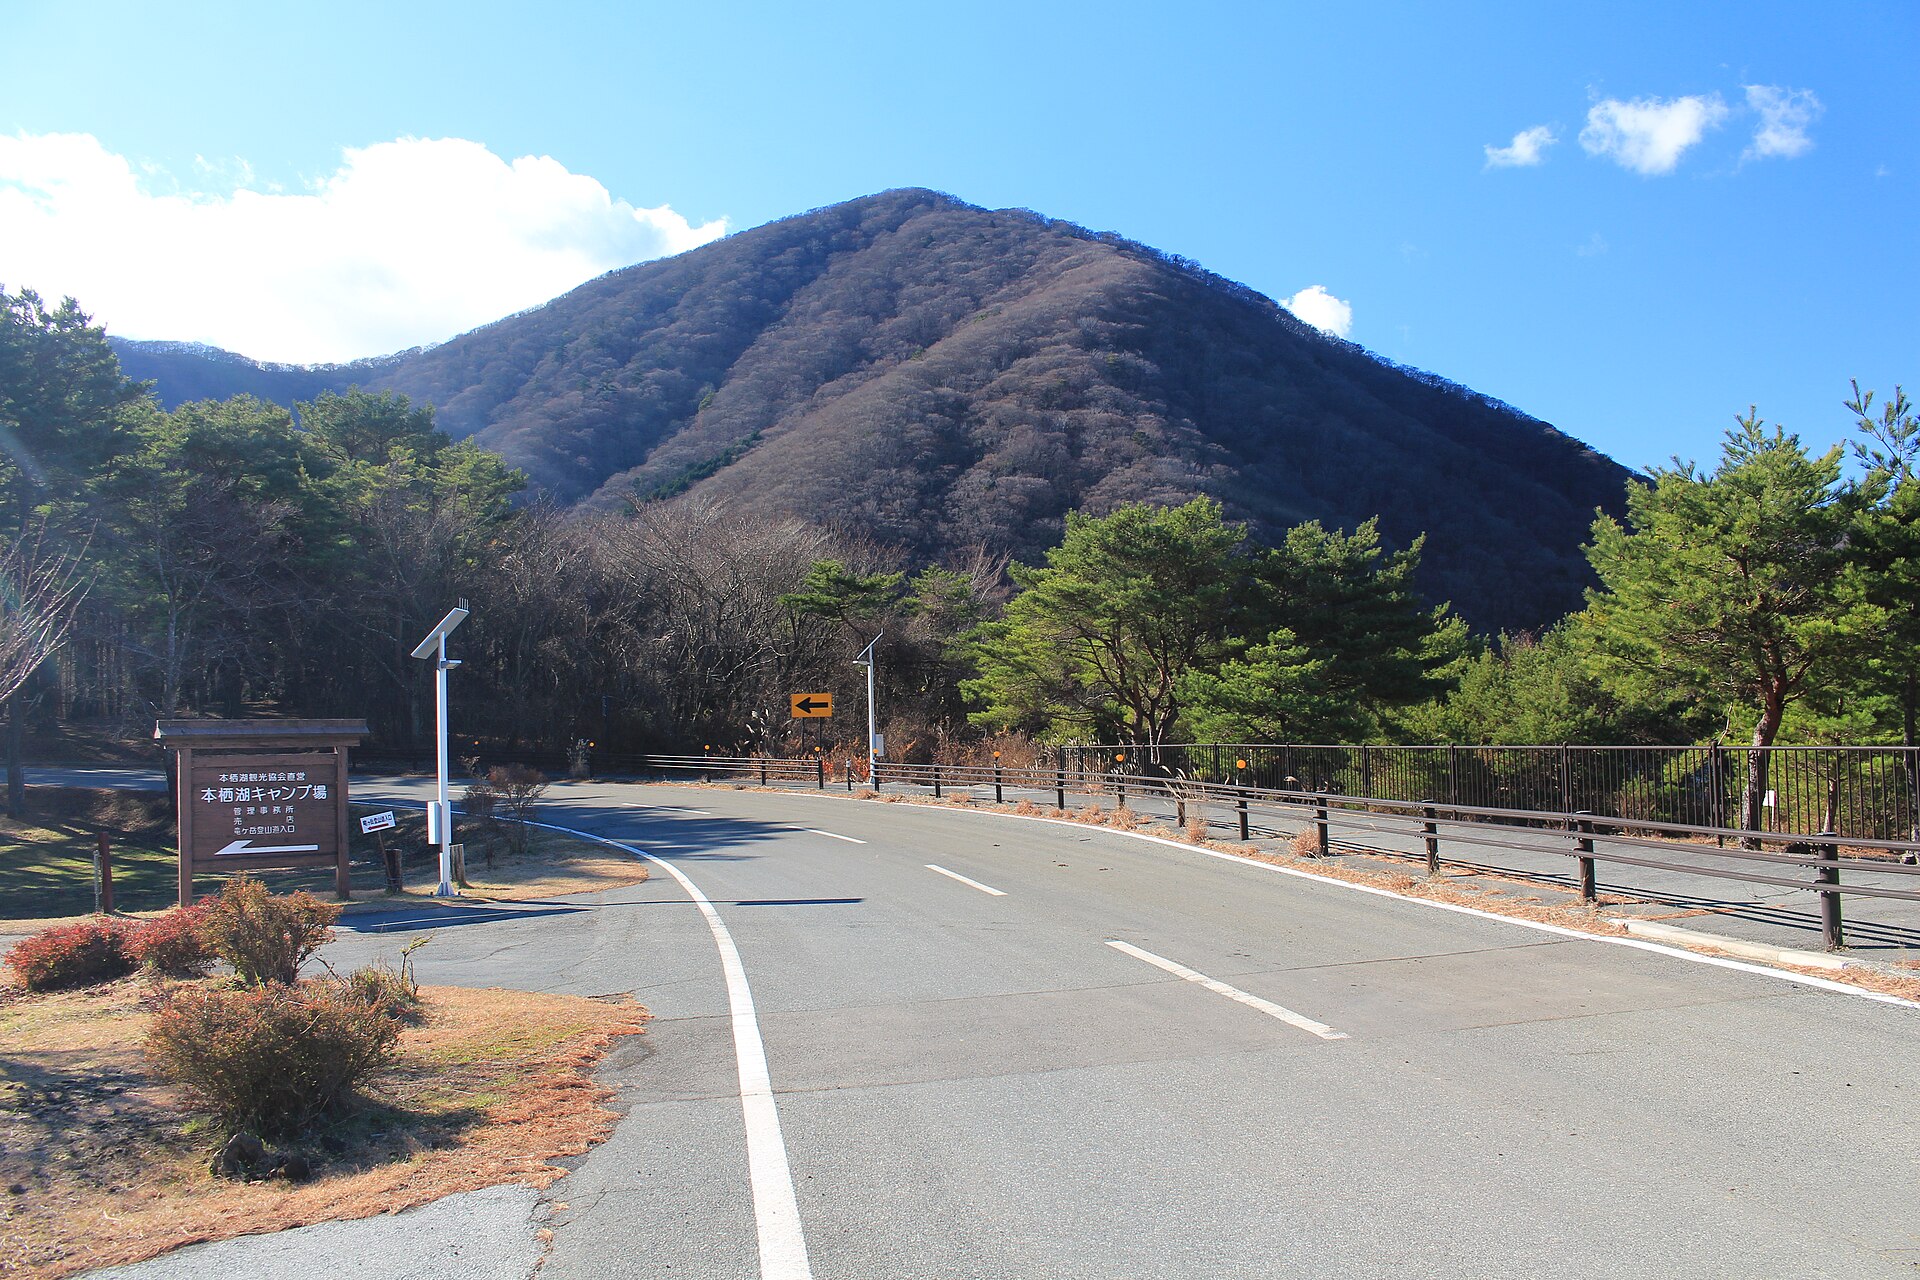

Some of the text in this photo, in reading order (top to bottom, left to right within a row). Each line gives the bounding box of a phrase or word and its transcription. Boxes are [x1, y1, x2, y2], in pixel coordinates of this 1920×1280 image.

[219, 772, 306, 783] 本栖湖観光協会直営
[201, 784, 327, 803] 本栖湖キャンプ場
